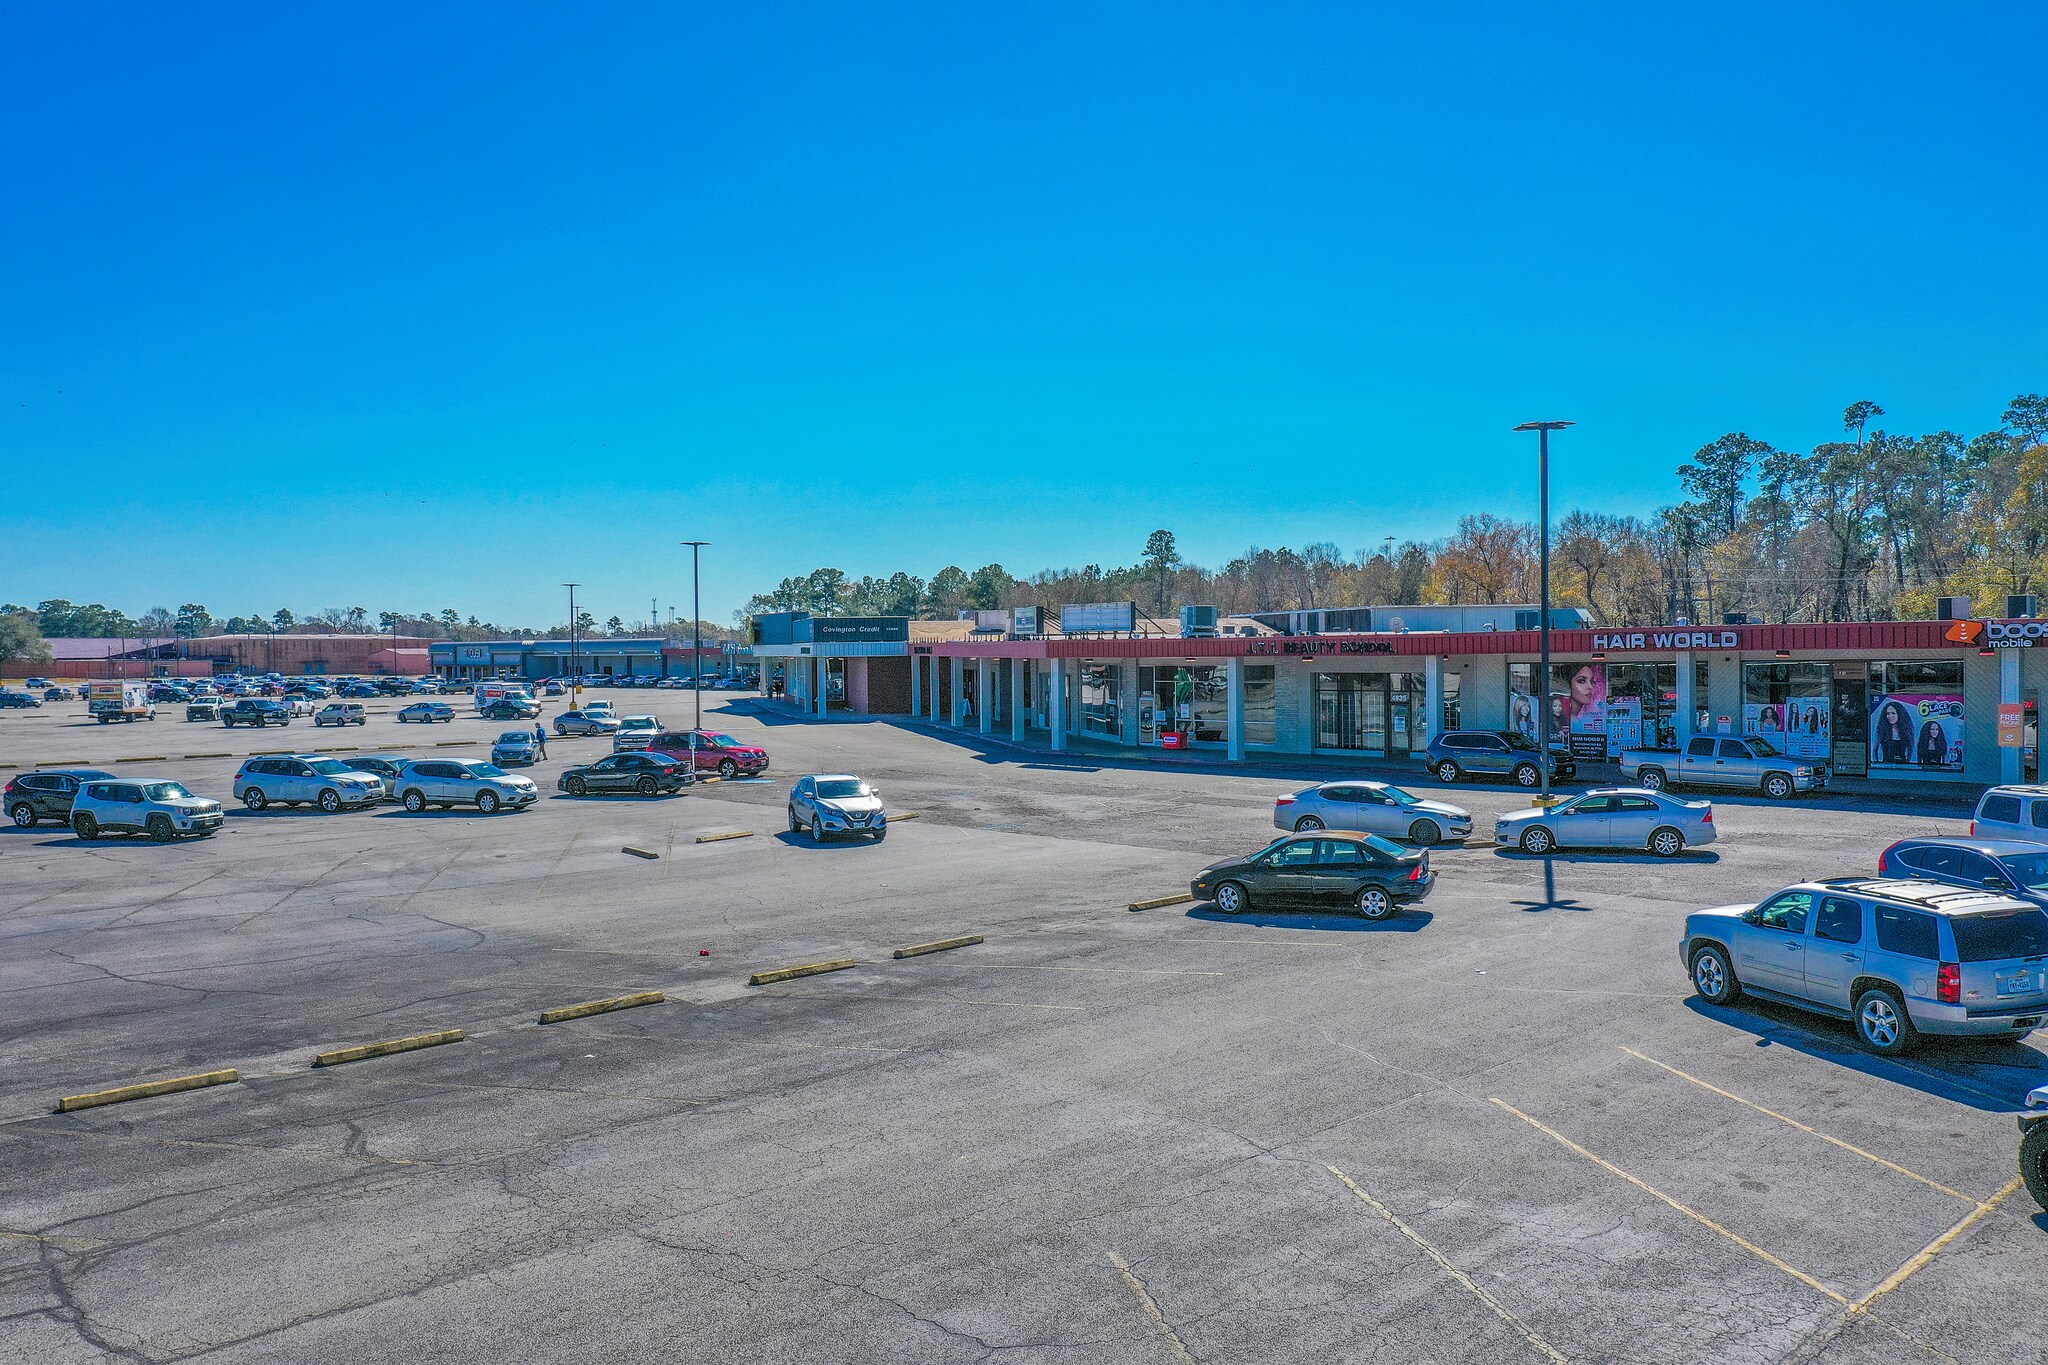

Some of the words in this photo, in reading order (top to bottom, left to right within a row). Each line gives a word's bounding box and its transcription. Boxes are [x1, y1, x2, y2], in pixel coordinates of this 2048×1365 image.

[822, 626, 856, 634] Covington
[1593, 633, 1646, 649] HAIR
[1653, 631, 1738, 648] WORLD
[1988, 639, 2033, 648] mobile
[1284, 640, 1336, 654] BEAUTY
[1341, 640, 1397, 654] SCHOOL
[1929, 702, 1948, 711] LACE
